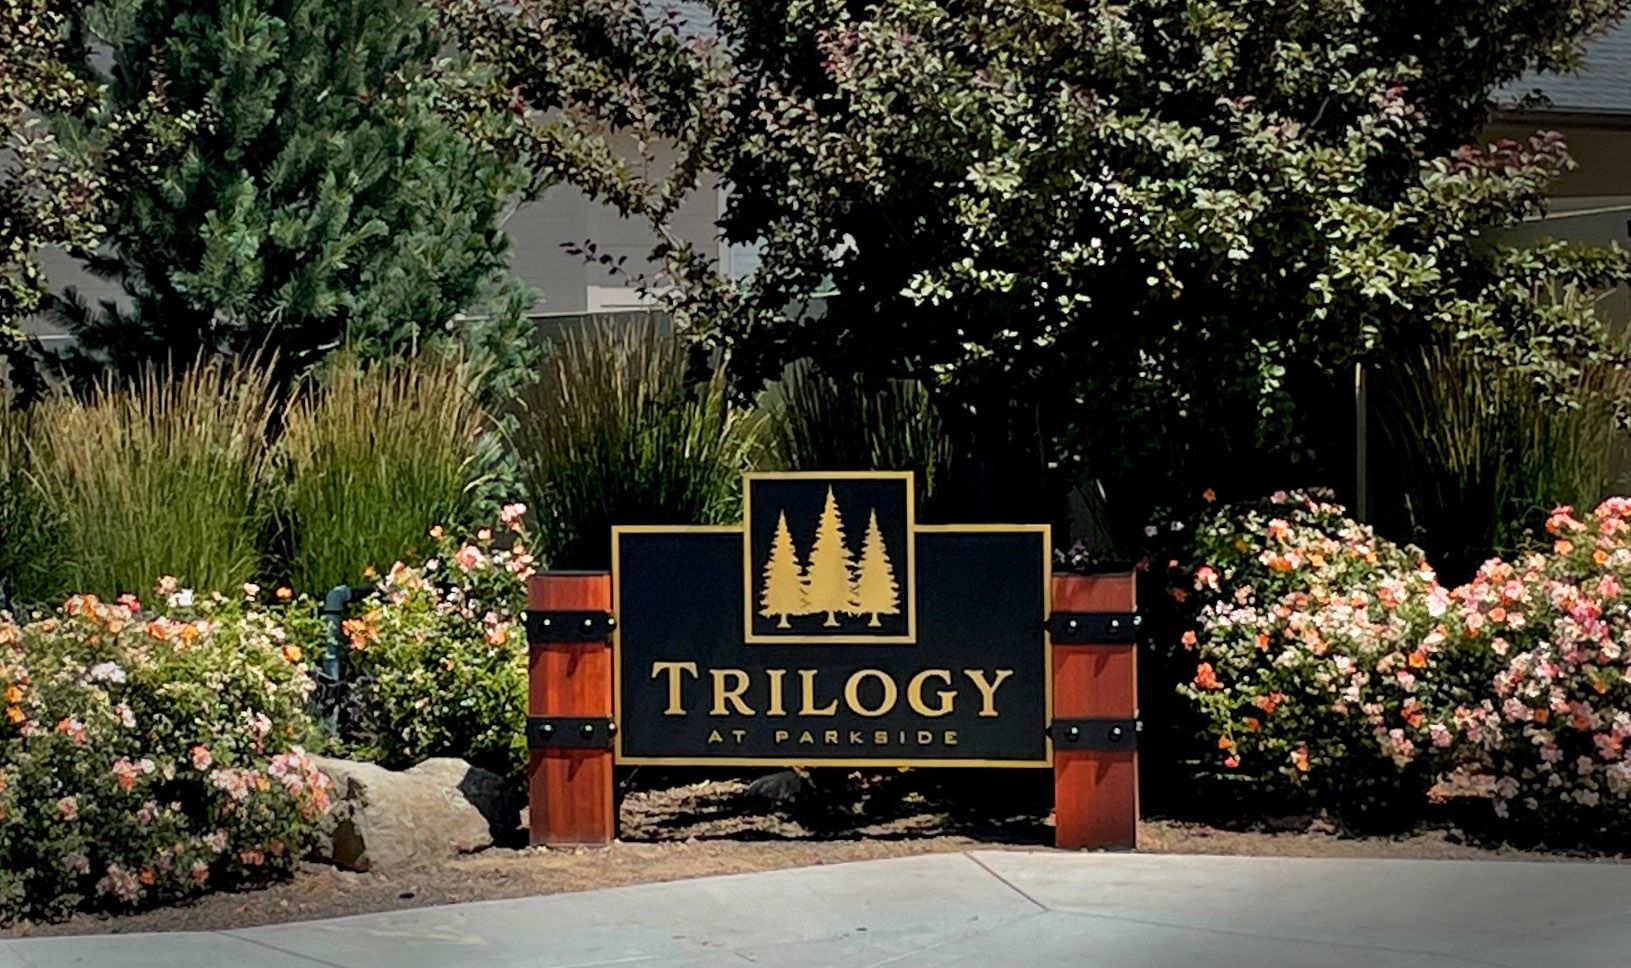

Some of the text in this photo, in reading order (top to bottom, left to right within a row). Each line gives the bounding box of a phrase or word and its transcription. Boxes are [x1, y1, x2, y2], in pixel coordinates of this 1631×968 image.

[651, 661, 1014, 717] TRILOGY
[707, 729, 959, 746] AT PARKSIDE
